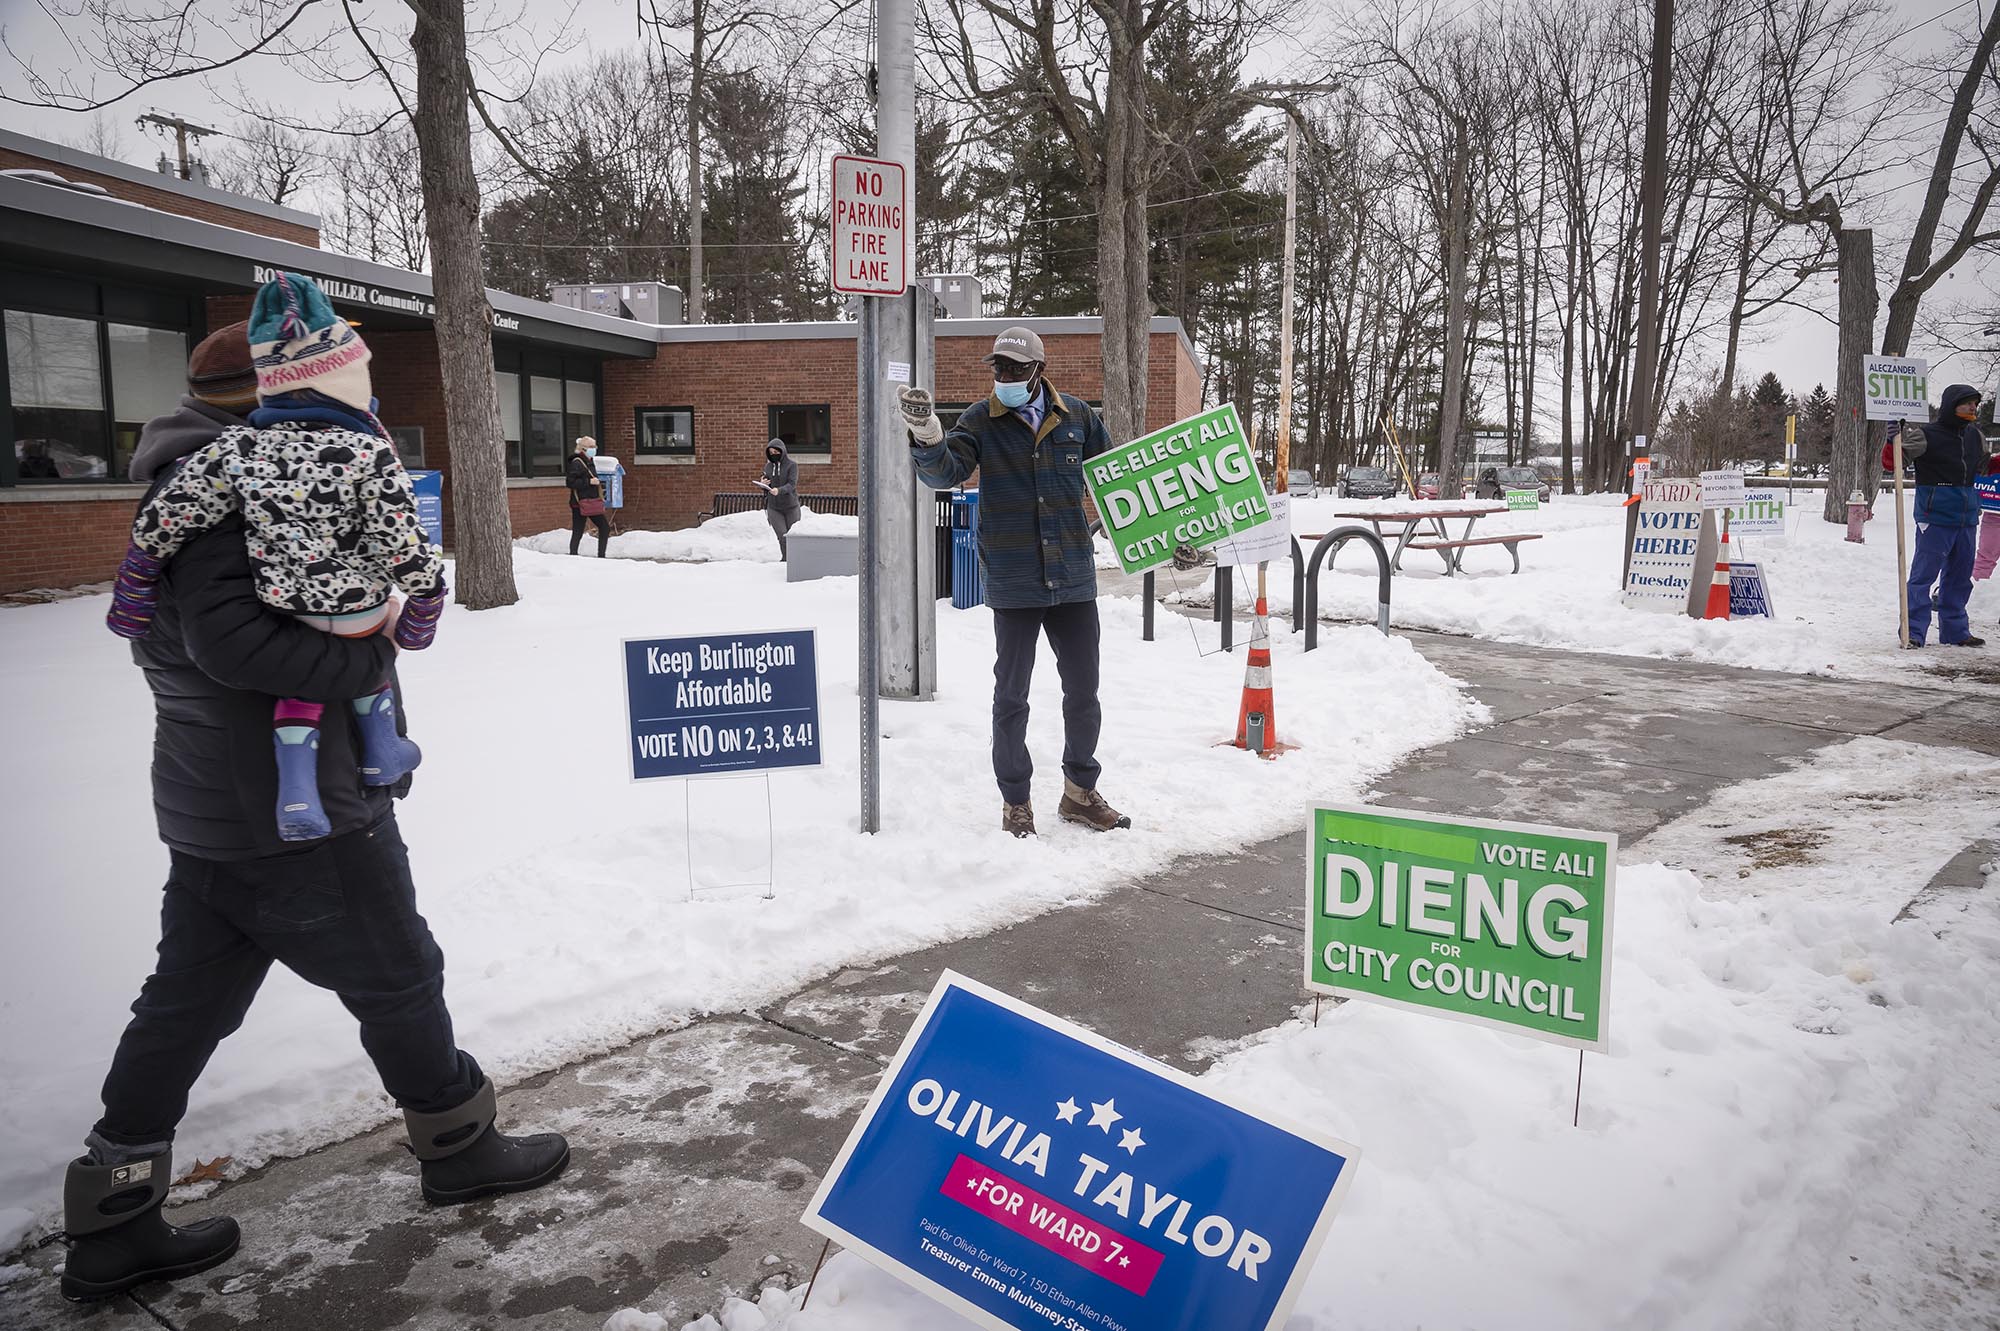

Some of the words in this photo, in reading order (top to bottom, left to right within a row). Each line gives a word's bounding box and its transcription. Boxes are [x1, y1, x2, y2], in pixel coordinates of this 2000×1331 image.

[856, 170, 882, 197] NO
[838, 200, 900, 230] PARKING
[852, 232, 887, 255] FIRE
[850, 259, 889, 282] LANE
[369, 289, 425, 316] Community
[493, 313, 520, 331] Center
[1869, 363, 1917, 375] ALECZANDER
[1867, 373, 1927, 401] STITH
[1873, 399, 1888, 407] WARD
[1888, 400, 1892, 408] 7
[1892, 400, 1902, 408] CITY
[1902, 400, 1922, 408] COUNCIL
[1093, 428, 1193, 488] RE-ELECT
[1200, 415, 1236, 445] ALI
[1103, 443, 1251, 531] DIENG
[1508, 494, 1537, 504] DIENG
[1644, 485, 1690, 503] WARD
[1695, 484, 1702, 503] 7
[1973, 482, 1996, 492] LIVIA
[1179, 505, 1197, 519] FOR
[1640, 512, 1700, 530] VOTE
[1123, 530, 1168, 563] CITY
[1174, 496, 1266, 544] COUNCIL
[1634, 537, 1697, 556] HERE
[1629, 572, 1691, 591] Tuesday
[647, 647, 693, 678] Keep
[700, 642, 795, 674] Burlington
[676, 677, 772, 708] Affordable
[638, 733, 678, 758] VOTE
[682, 725, 713, 757] NO
[718, 729, 741, 752] ON
[1481, 841, 1547, 872] VOTE
[1552, 851, 1595, 877] ALI
[1323, 852, 1590, 961] DIENG
[1431, 942, 1461, 958] FOR
[1323, 941, 1400, 982] CITY
[1408, 957, 1585, 1023] COUNCIL
[907, 1078, 1052, 1178] OLIVIA
[1073, 1152, 1272, 1283] TAYLOR
[975, 1176, 1024, 1216] FOR
[1028, 1202, 1101, 1255] WARD
[1103, 1240, 1124, 1264] 7
[919, 1217, 939, 1235] Paid
[940, 1226, 952, 1241] for
[953, 1236, 977, 1256] Olivia
[977, 1250, 992, 1264] for
[993, 1256, 1018, 1278] Ward
[1018, 1270, 1028, 1285] 7,
[1030, 1276, 1048, 1294] 150
[1049, 1287, 1076, 1309] Ethan
[1076, 1301, 1100, 1322] Allen
[920, 1237, 972, 1274] Treasurer
[971, 1266, 1006, 1294] Emma
